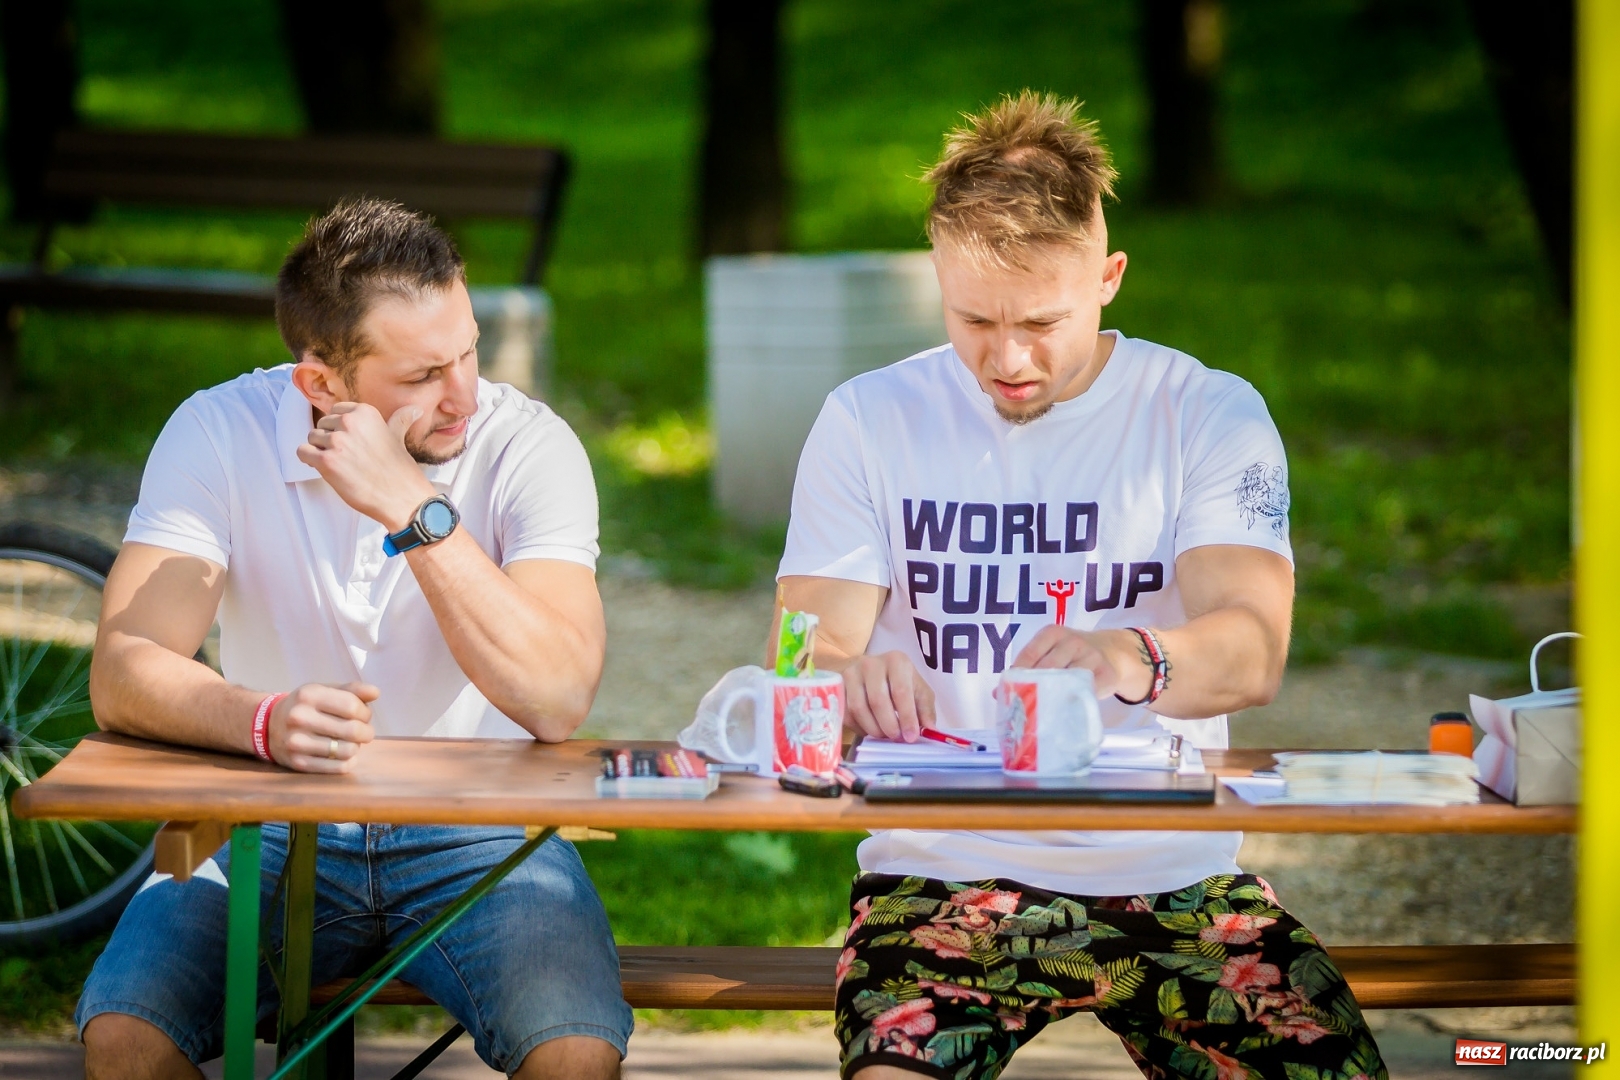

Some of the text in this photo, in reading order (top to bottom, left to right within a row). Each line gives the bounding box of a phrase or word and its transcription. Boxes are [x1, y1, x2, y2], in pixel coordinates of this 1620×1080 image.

[902, 498, 1099, 555] WORLD
[906, 560, 1164, 615] PULL UP
[912, 616, 1021, 674] DAY
